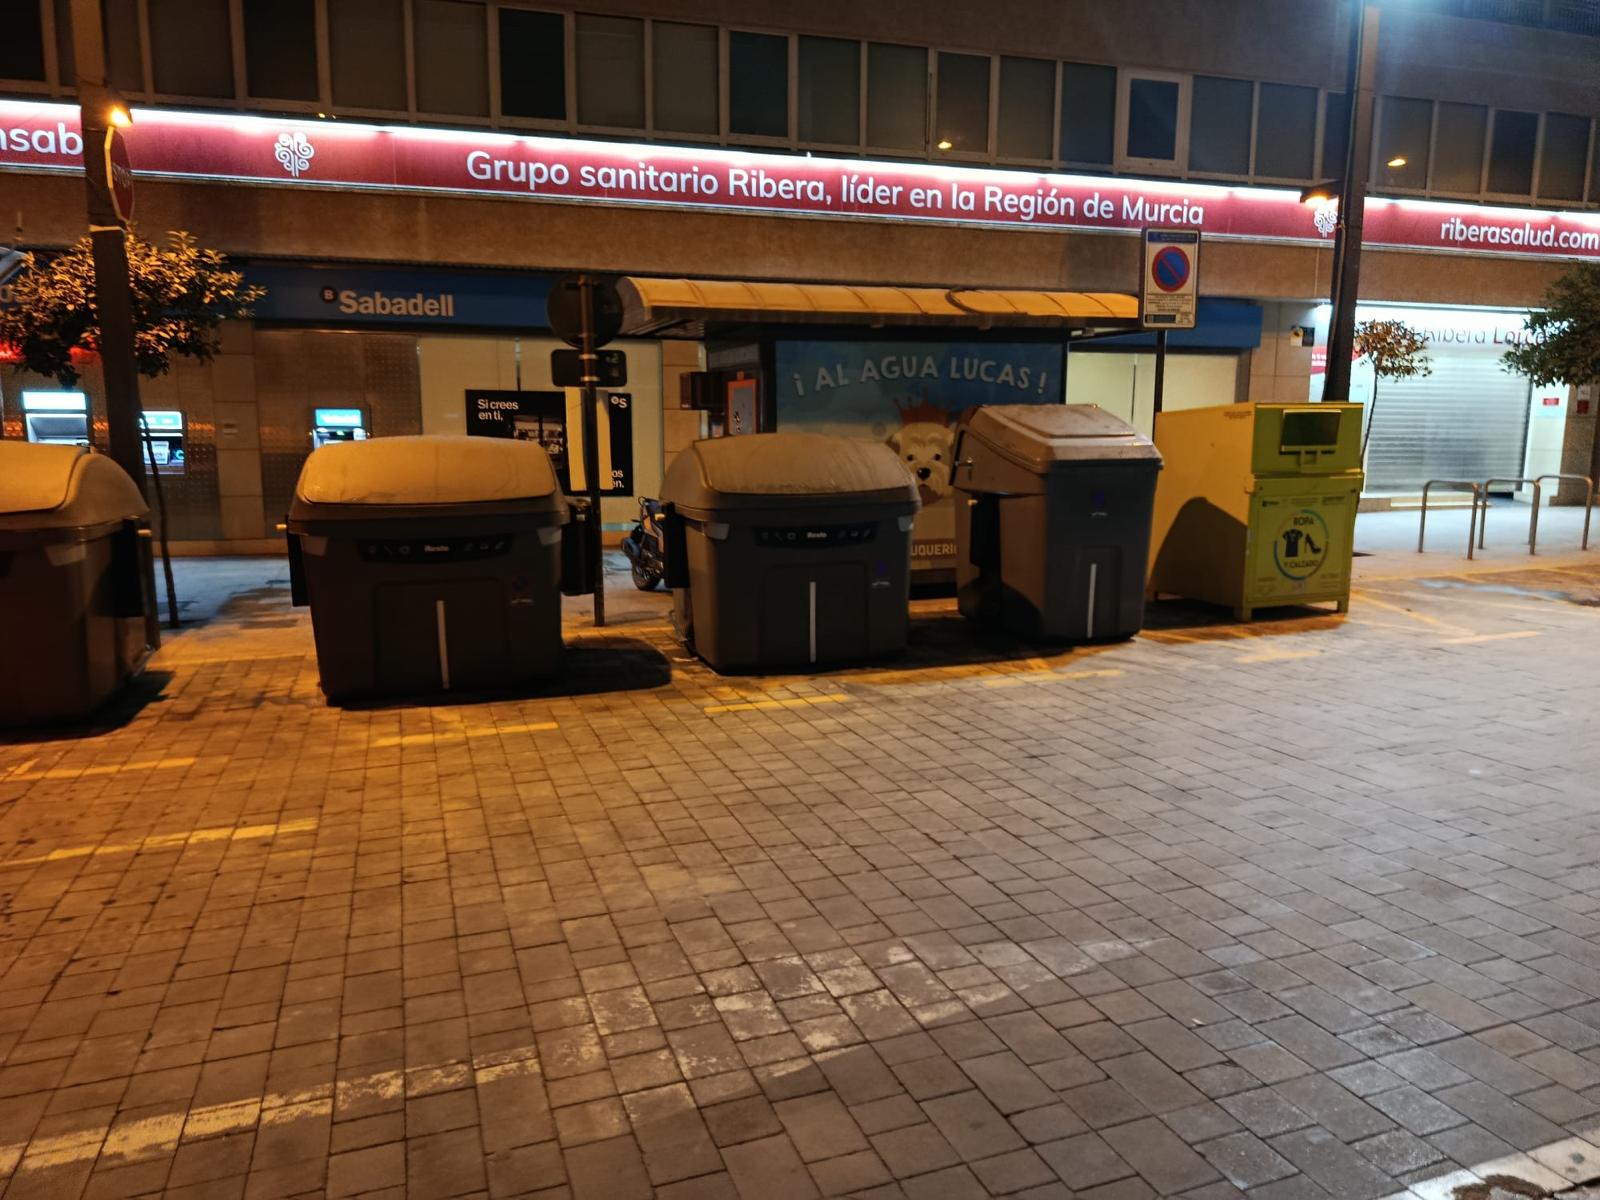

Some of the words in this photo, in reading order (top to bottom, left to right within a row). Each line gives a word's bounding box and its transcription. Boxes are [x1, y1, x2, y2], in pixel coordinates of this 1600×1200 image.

[466, 150, 570, 190] Grupo
[579, 161, 719, 195] sanitario
[728, 168, 832, 205] Ribera,
[841, 175, 903, 210] líder
[909, 187, 942, 209] en
[951, 183, 975, 211] la
[983, 185, 1075, 221] Región
[1083, 192, 1115, 219] de
[1122, 195, 1204, 225] Murcia
[1440, 217, 1600, 250] riberasalud.com
[338, 289, 455, 317] Sabadell
[860, 355, 939, 383] AGUA
[949, 356, 1031, 390] LUCAS
[478, 398, 489, 410] Si
[490, 400, 519, 410] crees
[478, 411, 492, 420] en
[1293, 516, 1315, 526] ROPA
